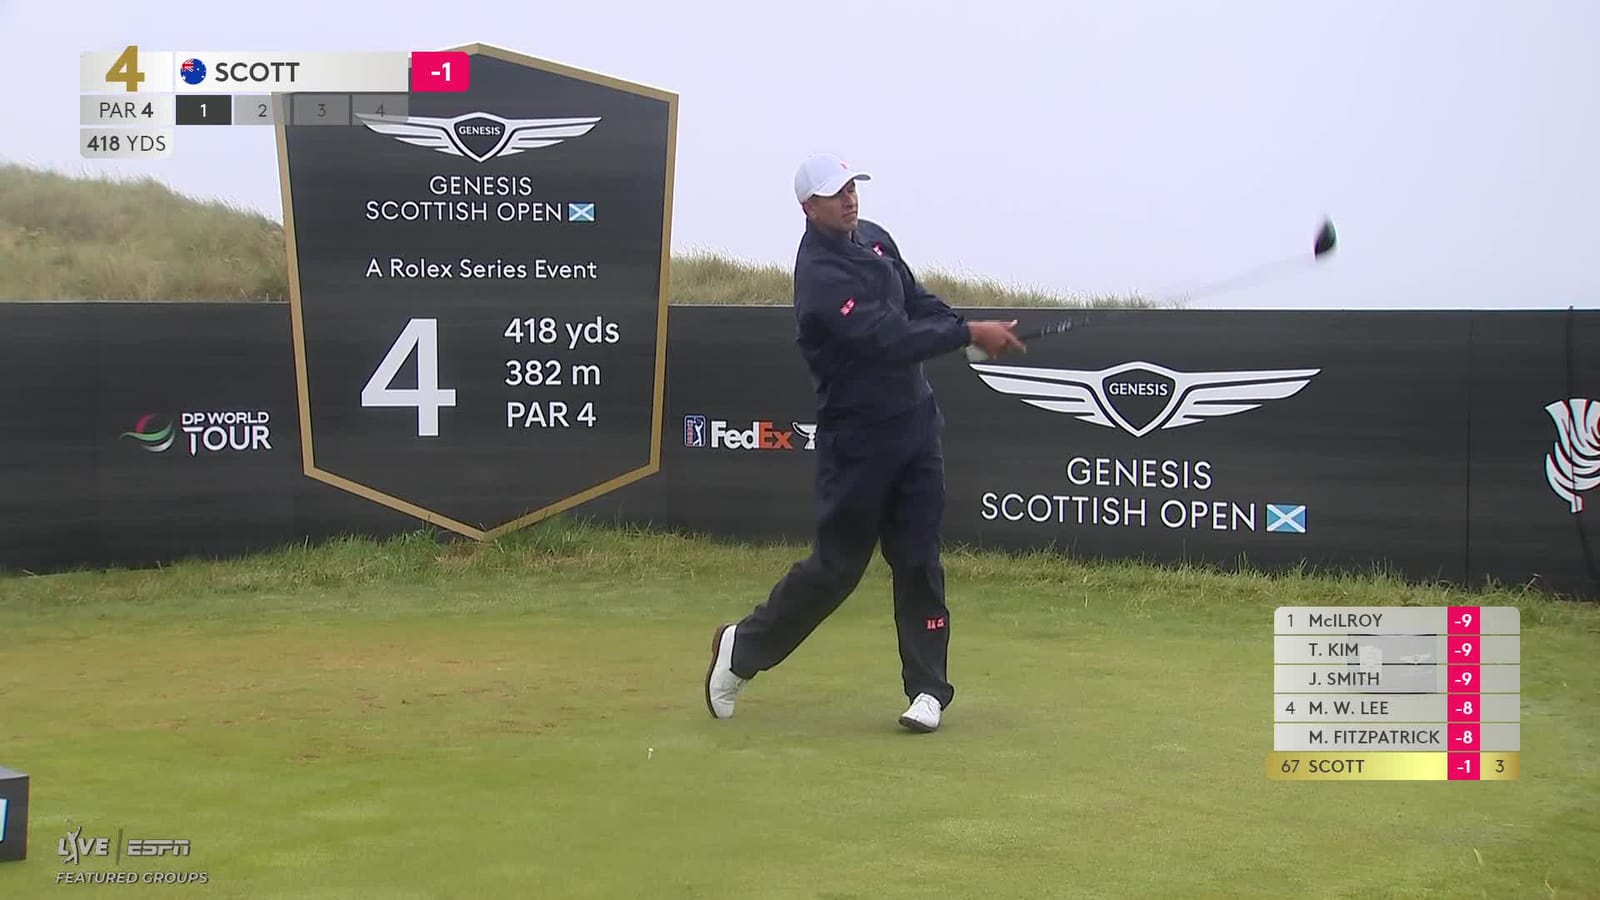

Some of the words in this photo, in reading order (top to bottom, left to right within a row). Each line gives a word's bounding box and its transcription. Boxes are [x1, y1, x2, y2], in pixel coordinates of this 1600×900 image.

[458, 124, 501, 137] GENESIS
[429, 175, 532, 196] GENESIS
[366, 201, 487, 222] SCOTTISH
[497, 202, 562, 222] OPEN
[366, 258, 383, 278] A
[390, 258, 452, 279] Rolex
[460, 259, 527, 279] Series
[535, 259, 598, 280] Event
[504, 318, 557, 344] 418
[565, 316, 620, 349] yds
[361, 317, 457, 437] 4
[504, 359, 562, 386] 382
[572, 364, 601, 385] m
[1108, 382, 1168, 397] GENESIS
[182, 413, 205, 425] DP
[207, 412, 270, 424] WORLD
[507, 401, 570, 428] PAR
[577, 401, 596, 427] 4
[182, 425, 272, 456] TOUR
[711, 421, 793, 449] FedEx
[1066, 457, 1212, 489] GENESIS
[981, 492, 1147, 527] SCOTTISH
[1160, 500, 1256, 532] OPEN
